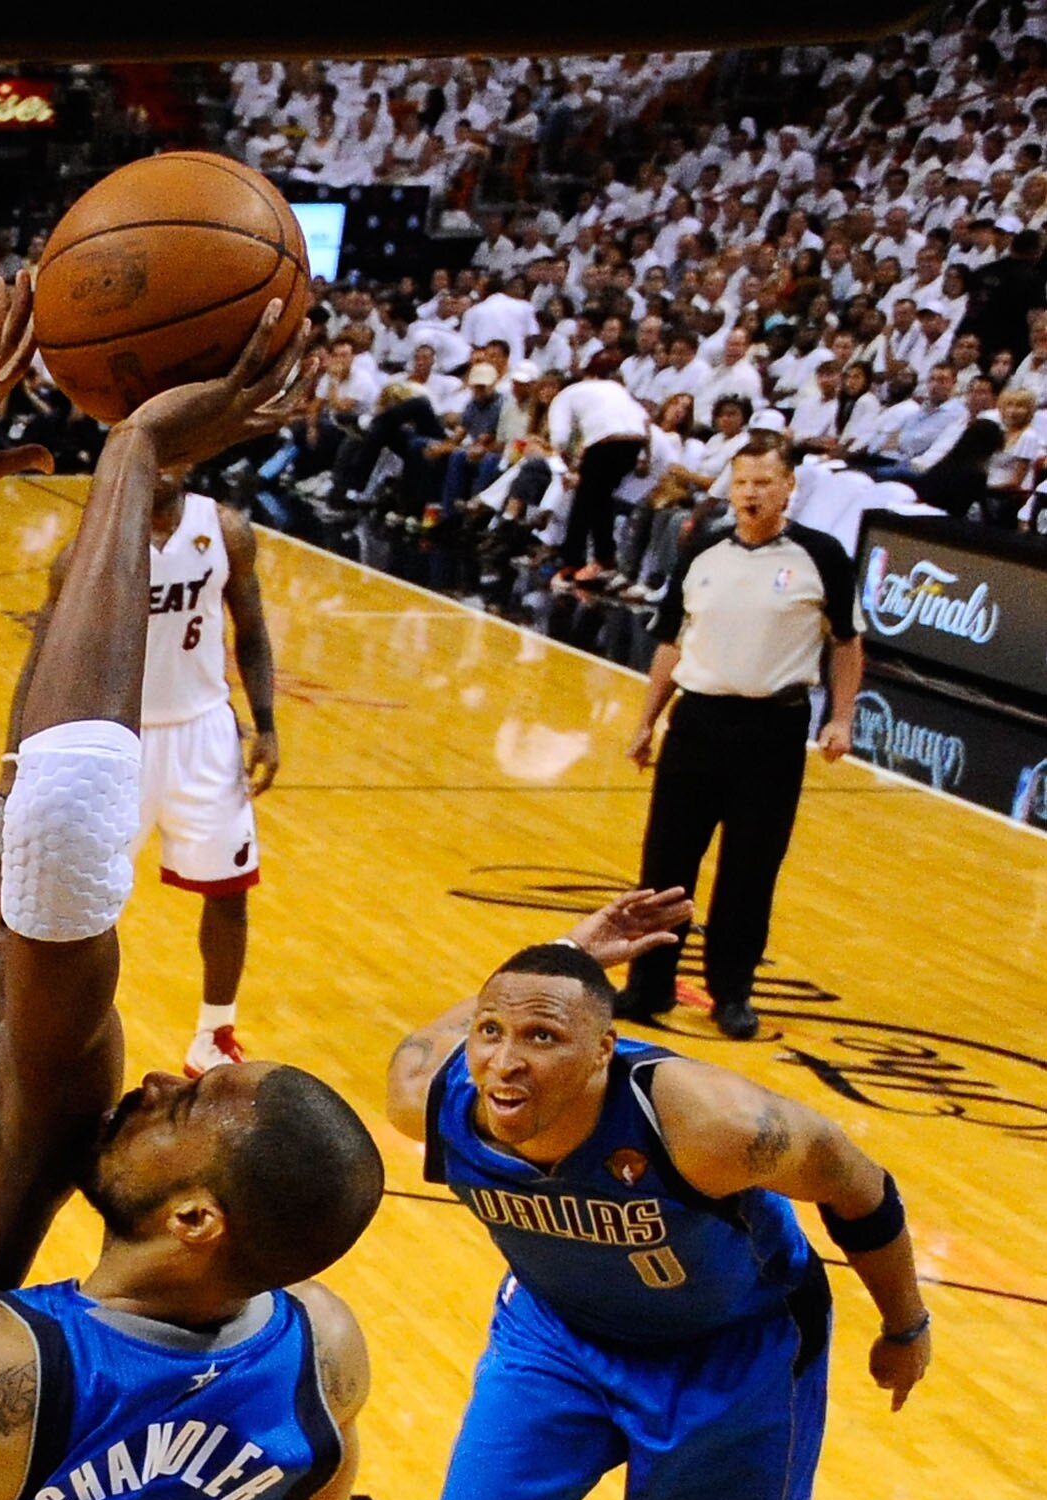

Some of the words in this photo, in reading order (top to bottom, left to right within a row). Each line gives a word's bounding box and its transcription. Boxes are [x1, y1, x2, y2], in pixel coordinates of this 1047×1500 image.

[149, 565, 213, 615] EAT
[870, 560, 1000, 644] Finals
[182, 615, 203, 651] 6
[470, 1187, 667, 1246] DALLAS
[627, 1246, 688, 1290] 0
